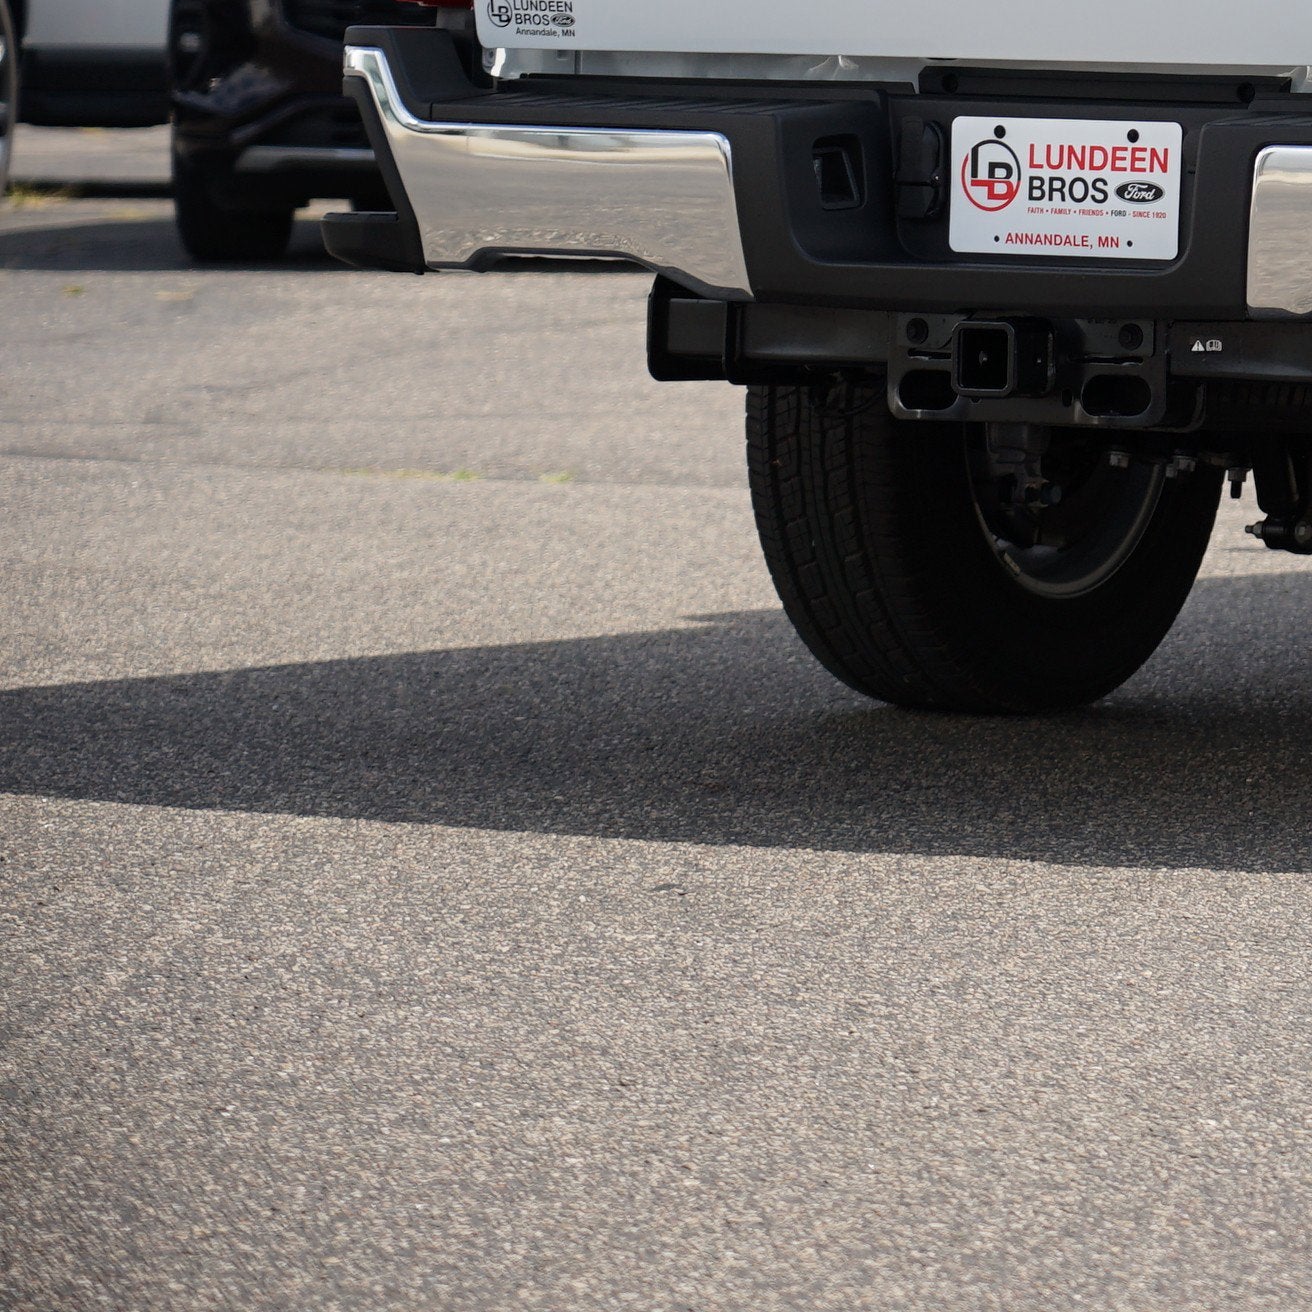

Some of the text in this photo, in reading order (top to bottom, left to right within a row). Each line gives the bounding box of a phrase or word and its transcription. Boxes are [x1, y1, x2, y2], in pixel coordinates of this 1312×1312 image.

[513, 0, 573, 13] LUNDEEN
[514, 14, 550, 26] BROS
[561, 29, 575, 37] MN
[1028, 143, 1170, 174] LUNDEEN
[1028, 176, 1109, 204] BROS
[1027, 206, 1044, 215] FAITH
[1050, 207, 1071, 216] FAMILY
[1078, 209, 1104, 217] FRIENDS
[1132, 210, 1150, 219] SINCE
[1005, 232, 1120, 250] ANNANDALE, MN
